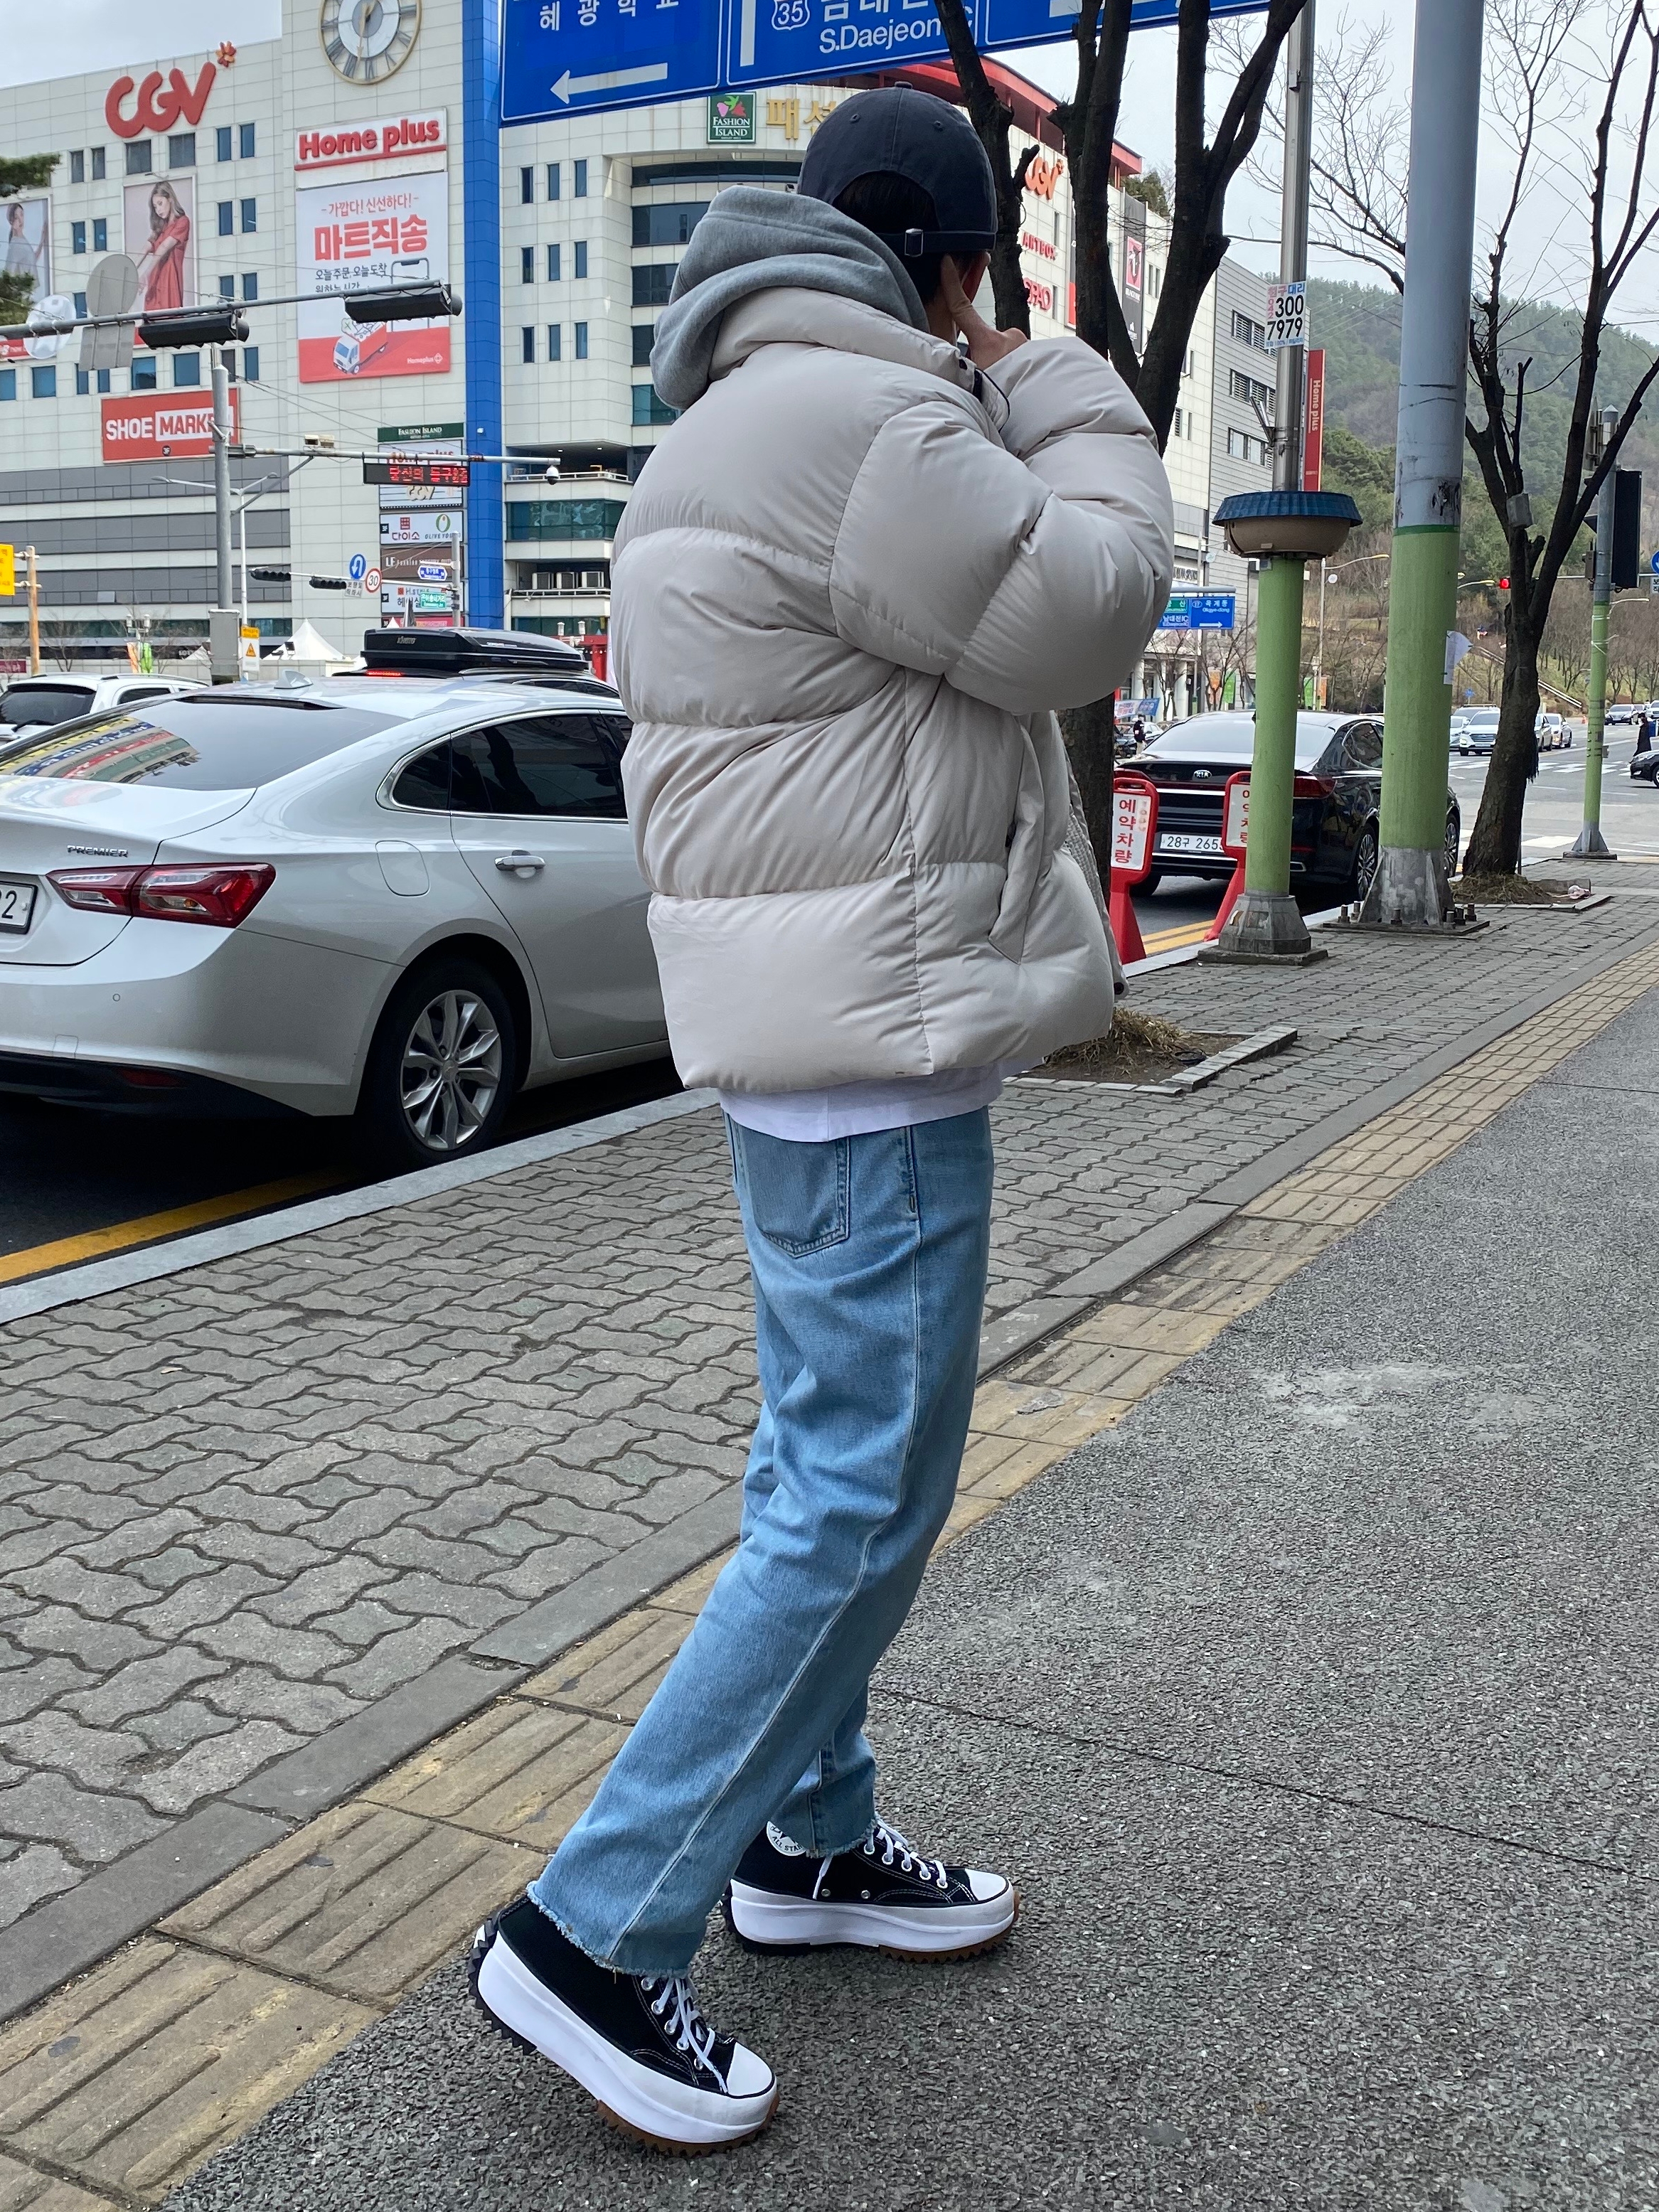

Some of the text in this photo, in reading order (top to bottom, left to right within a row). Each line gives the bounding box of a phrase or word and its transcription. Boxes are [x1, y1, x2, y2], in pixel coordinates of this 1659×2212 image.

[777, 0, 804, 26] 35
[819, 18, 941, 53] S.Daejeon
[105, 61, 215, 138] CGV
[713, 116, 750, 126] FASHION
[715, 126, 748, 137] ISLAND
[299, 119, 439, 160] Home plus
[314, 214, 427, 261] 마트직송
[1275, 294, 1304, 318] 300
[1267, 316, 1303, 341] 7979
[1311, 380, 1321, 432] Home plus
[106, 417, 153, 440] SHOE
[392, 531, 420, 540] 다이소
[369, 575, 378, 587] 30
[1114, 798, 1136, 864] 예약차량
[1167, 835, 1190, 848] 28구
[67, 844, 129, 857] PREMIER
